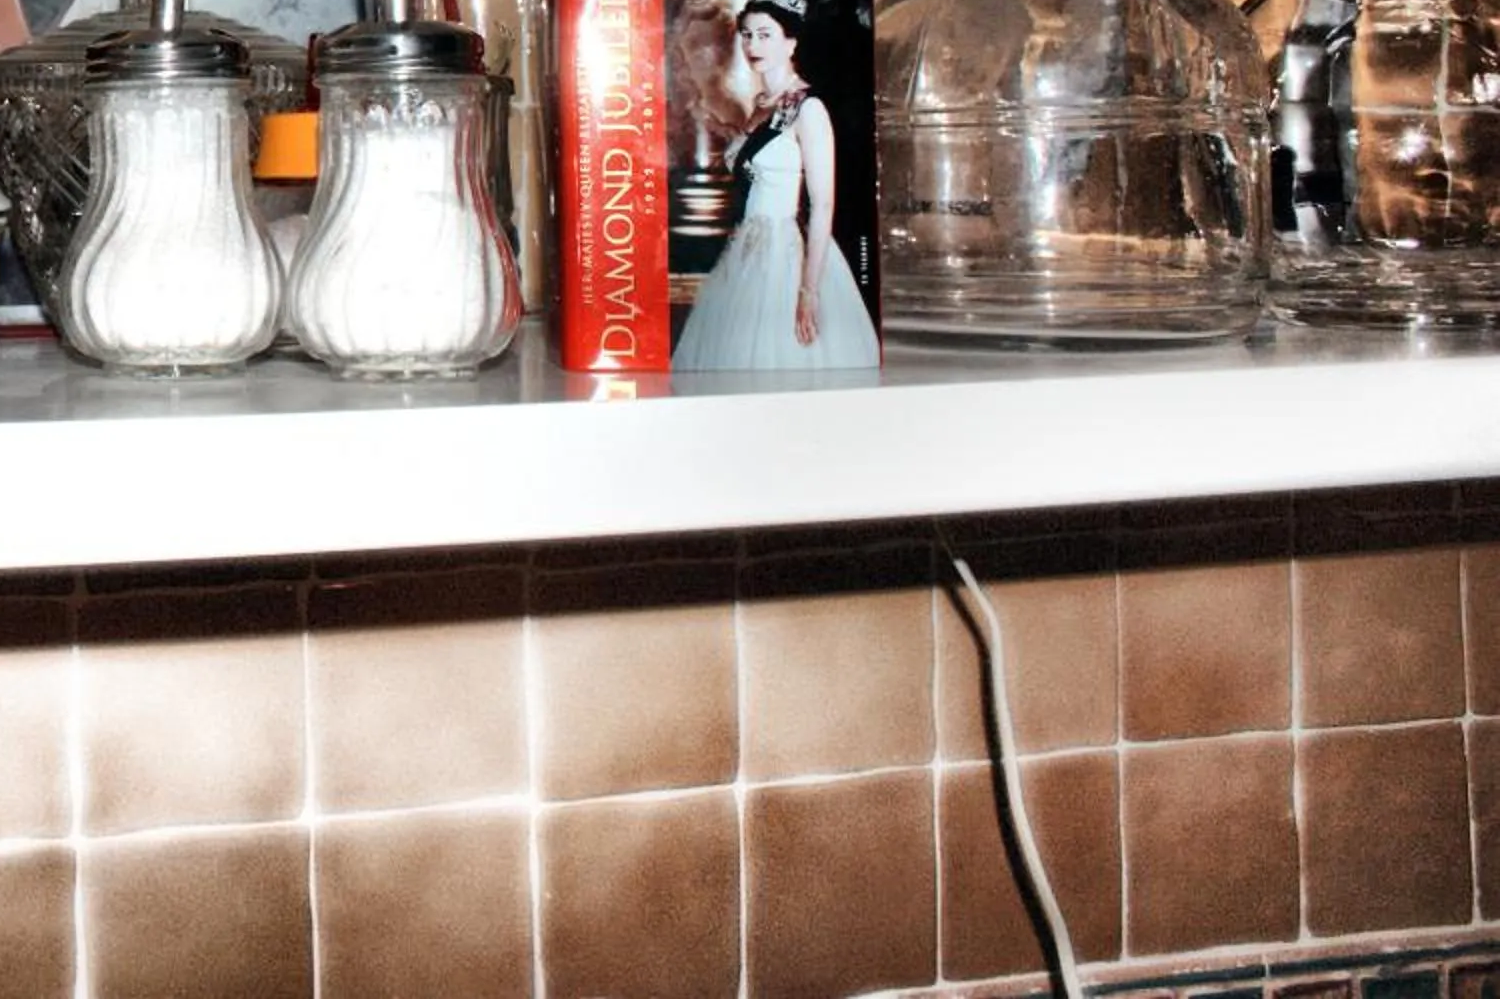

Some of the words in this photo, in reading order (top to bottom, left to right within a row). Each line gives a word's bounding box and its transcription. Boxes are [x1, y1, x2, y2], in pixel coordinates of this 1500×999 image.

[579, 143, 593, 198] QUEEN
[579, 203, 593, 270] MAJESTY
[601, 148, 638, 358] DIAMOND
[582, 274, 594, 305] HER
